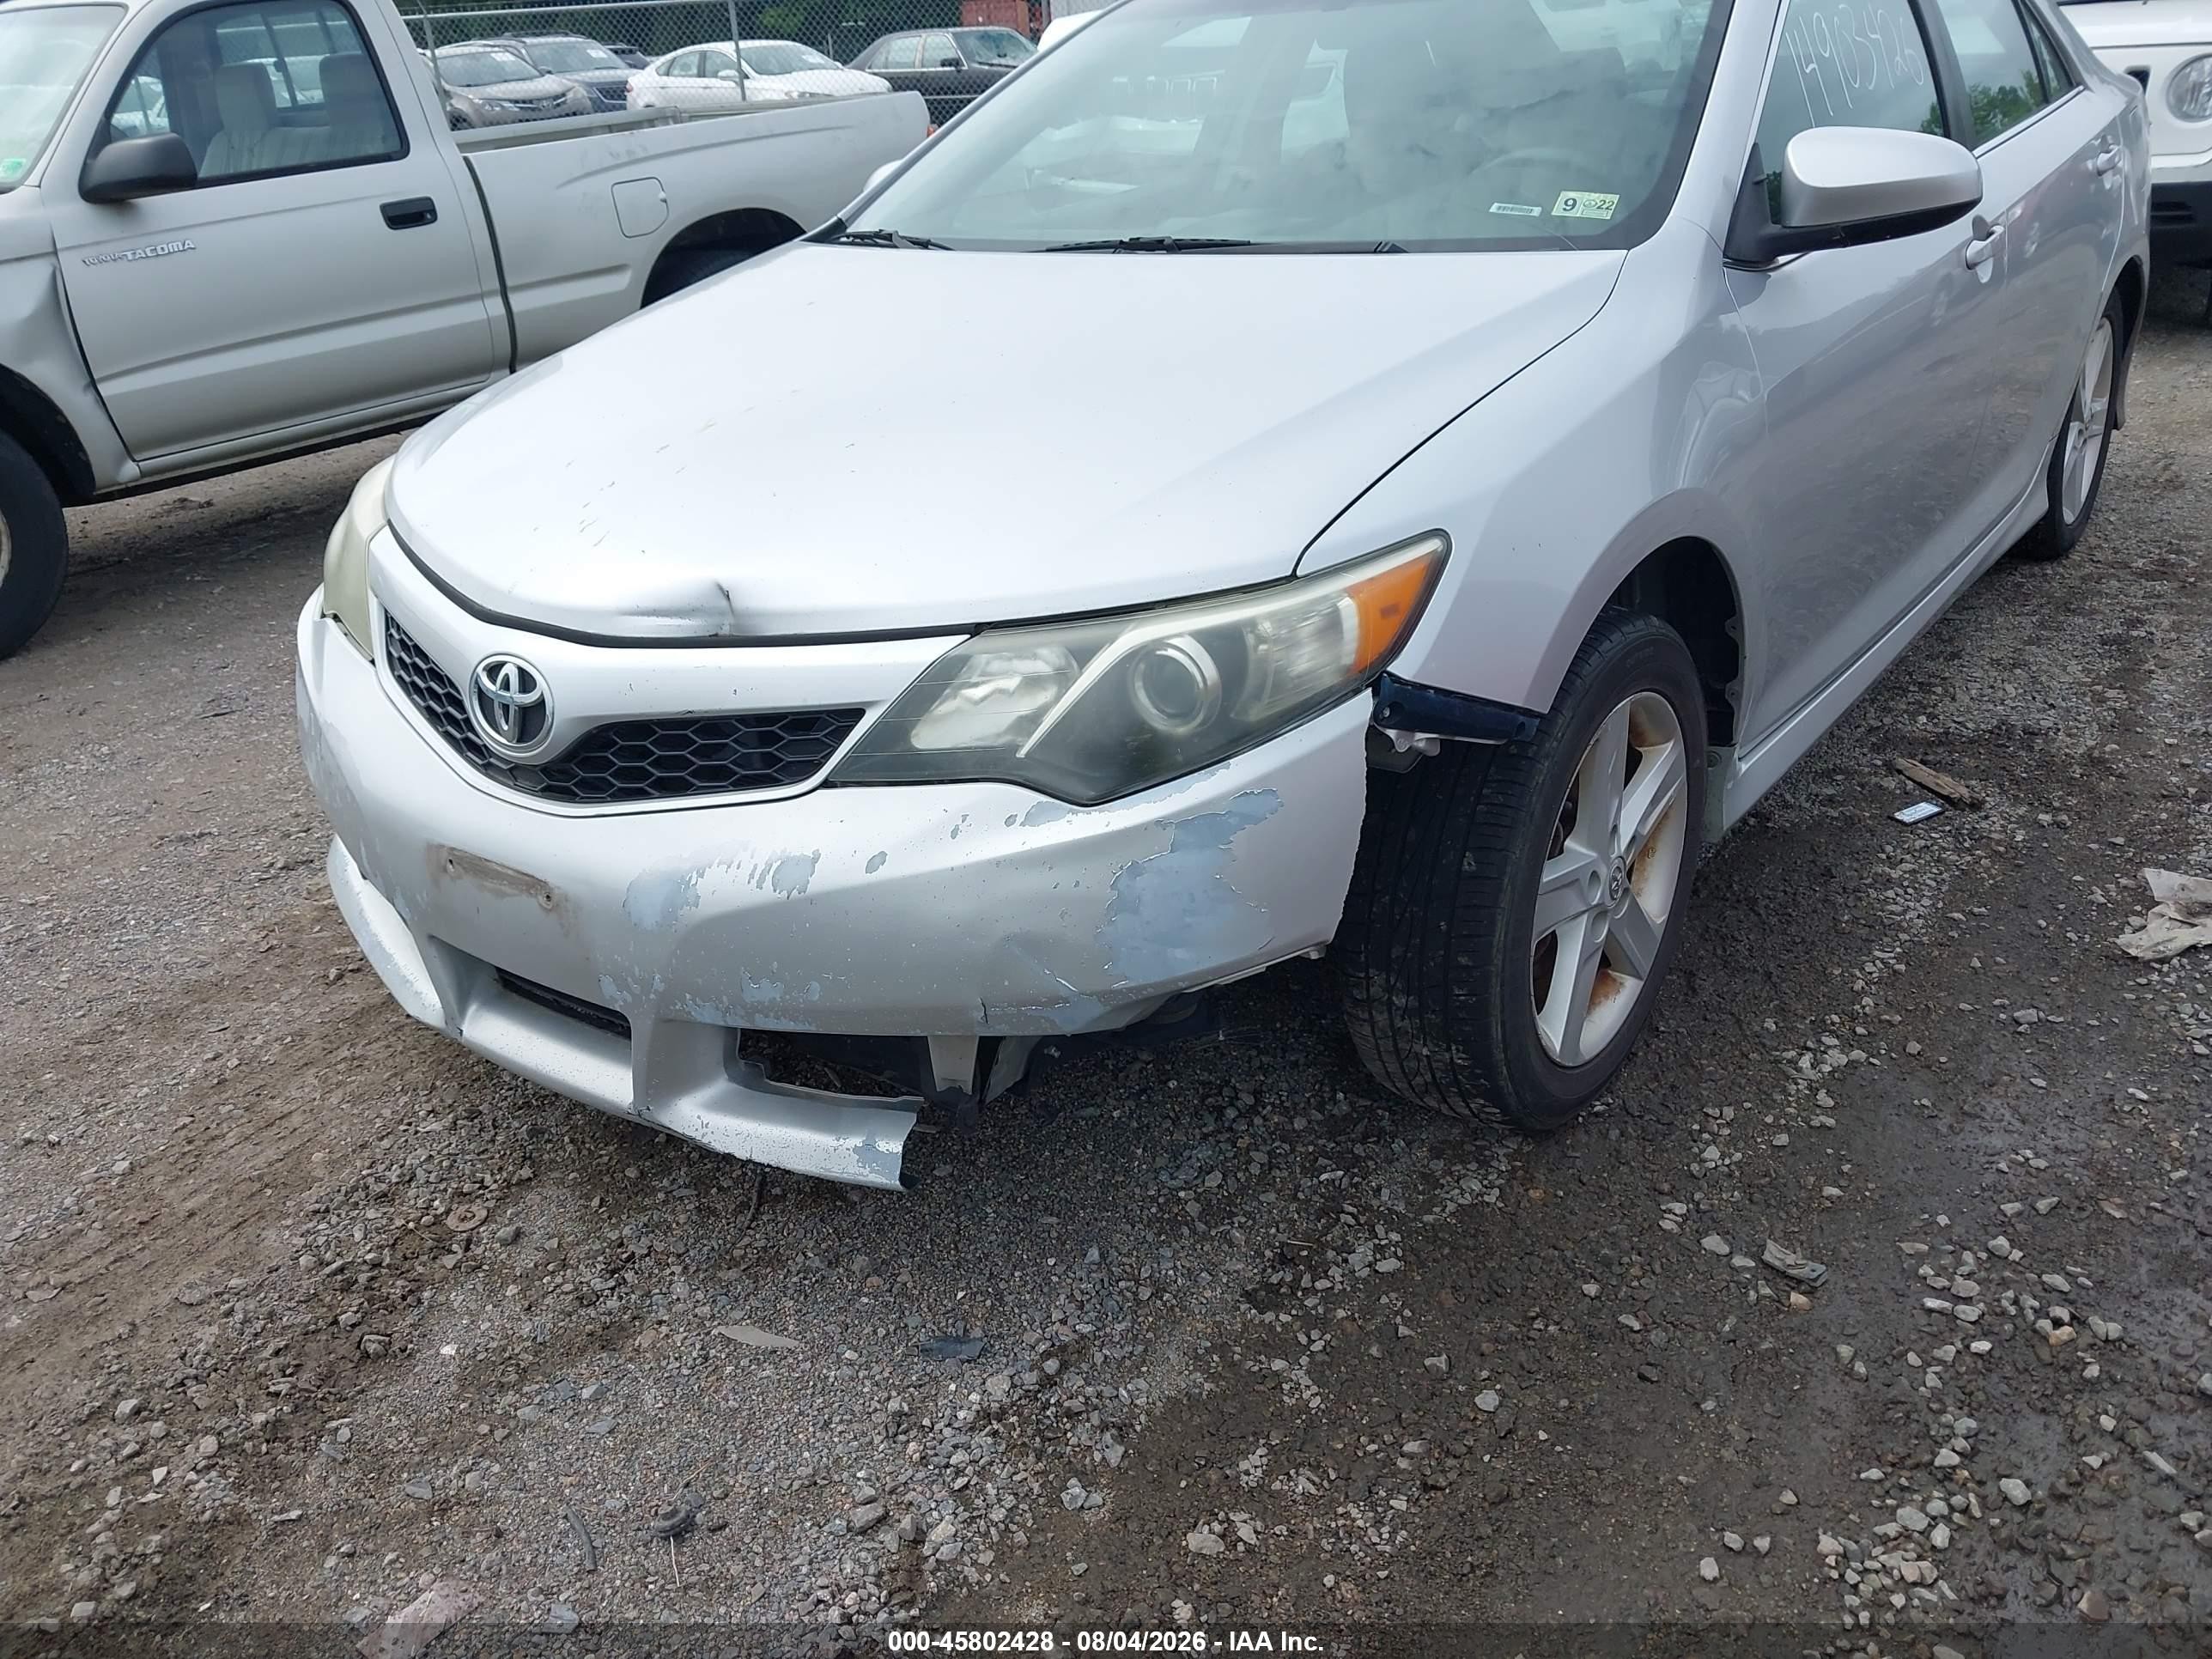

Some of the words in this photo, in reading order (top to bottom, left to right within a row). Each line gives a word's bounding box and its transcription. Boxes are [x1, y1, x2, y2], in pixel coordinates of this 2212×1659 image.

[1562, 198, 1577, 212] 9
[1596, 199, 1615, 211] 22
[122, 240, 196, 261] TACOMA
